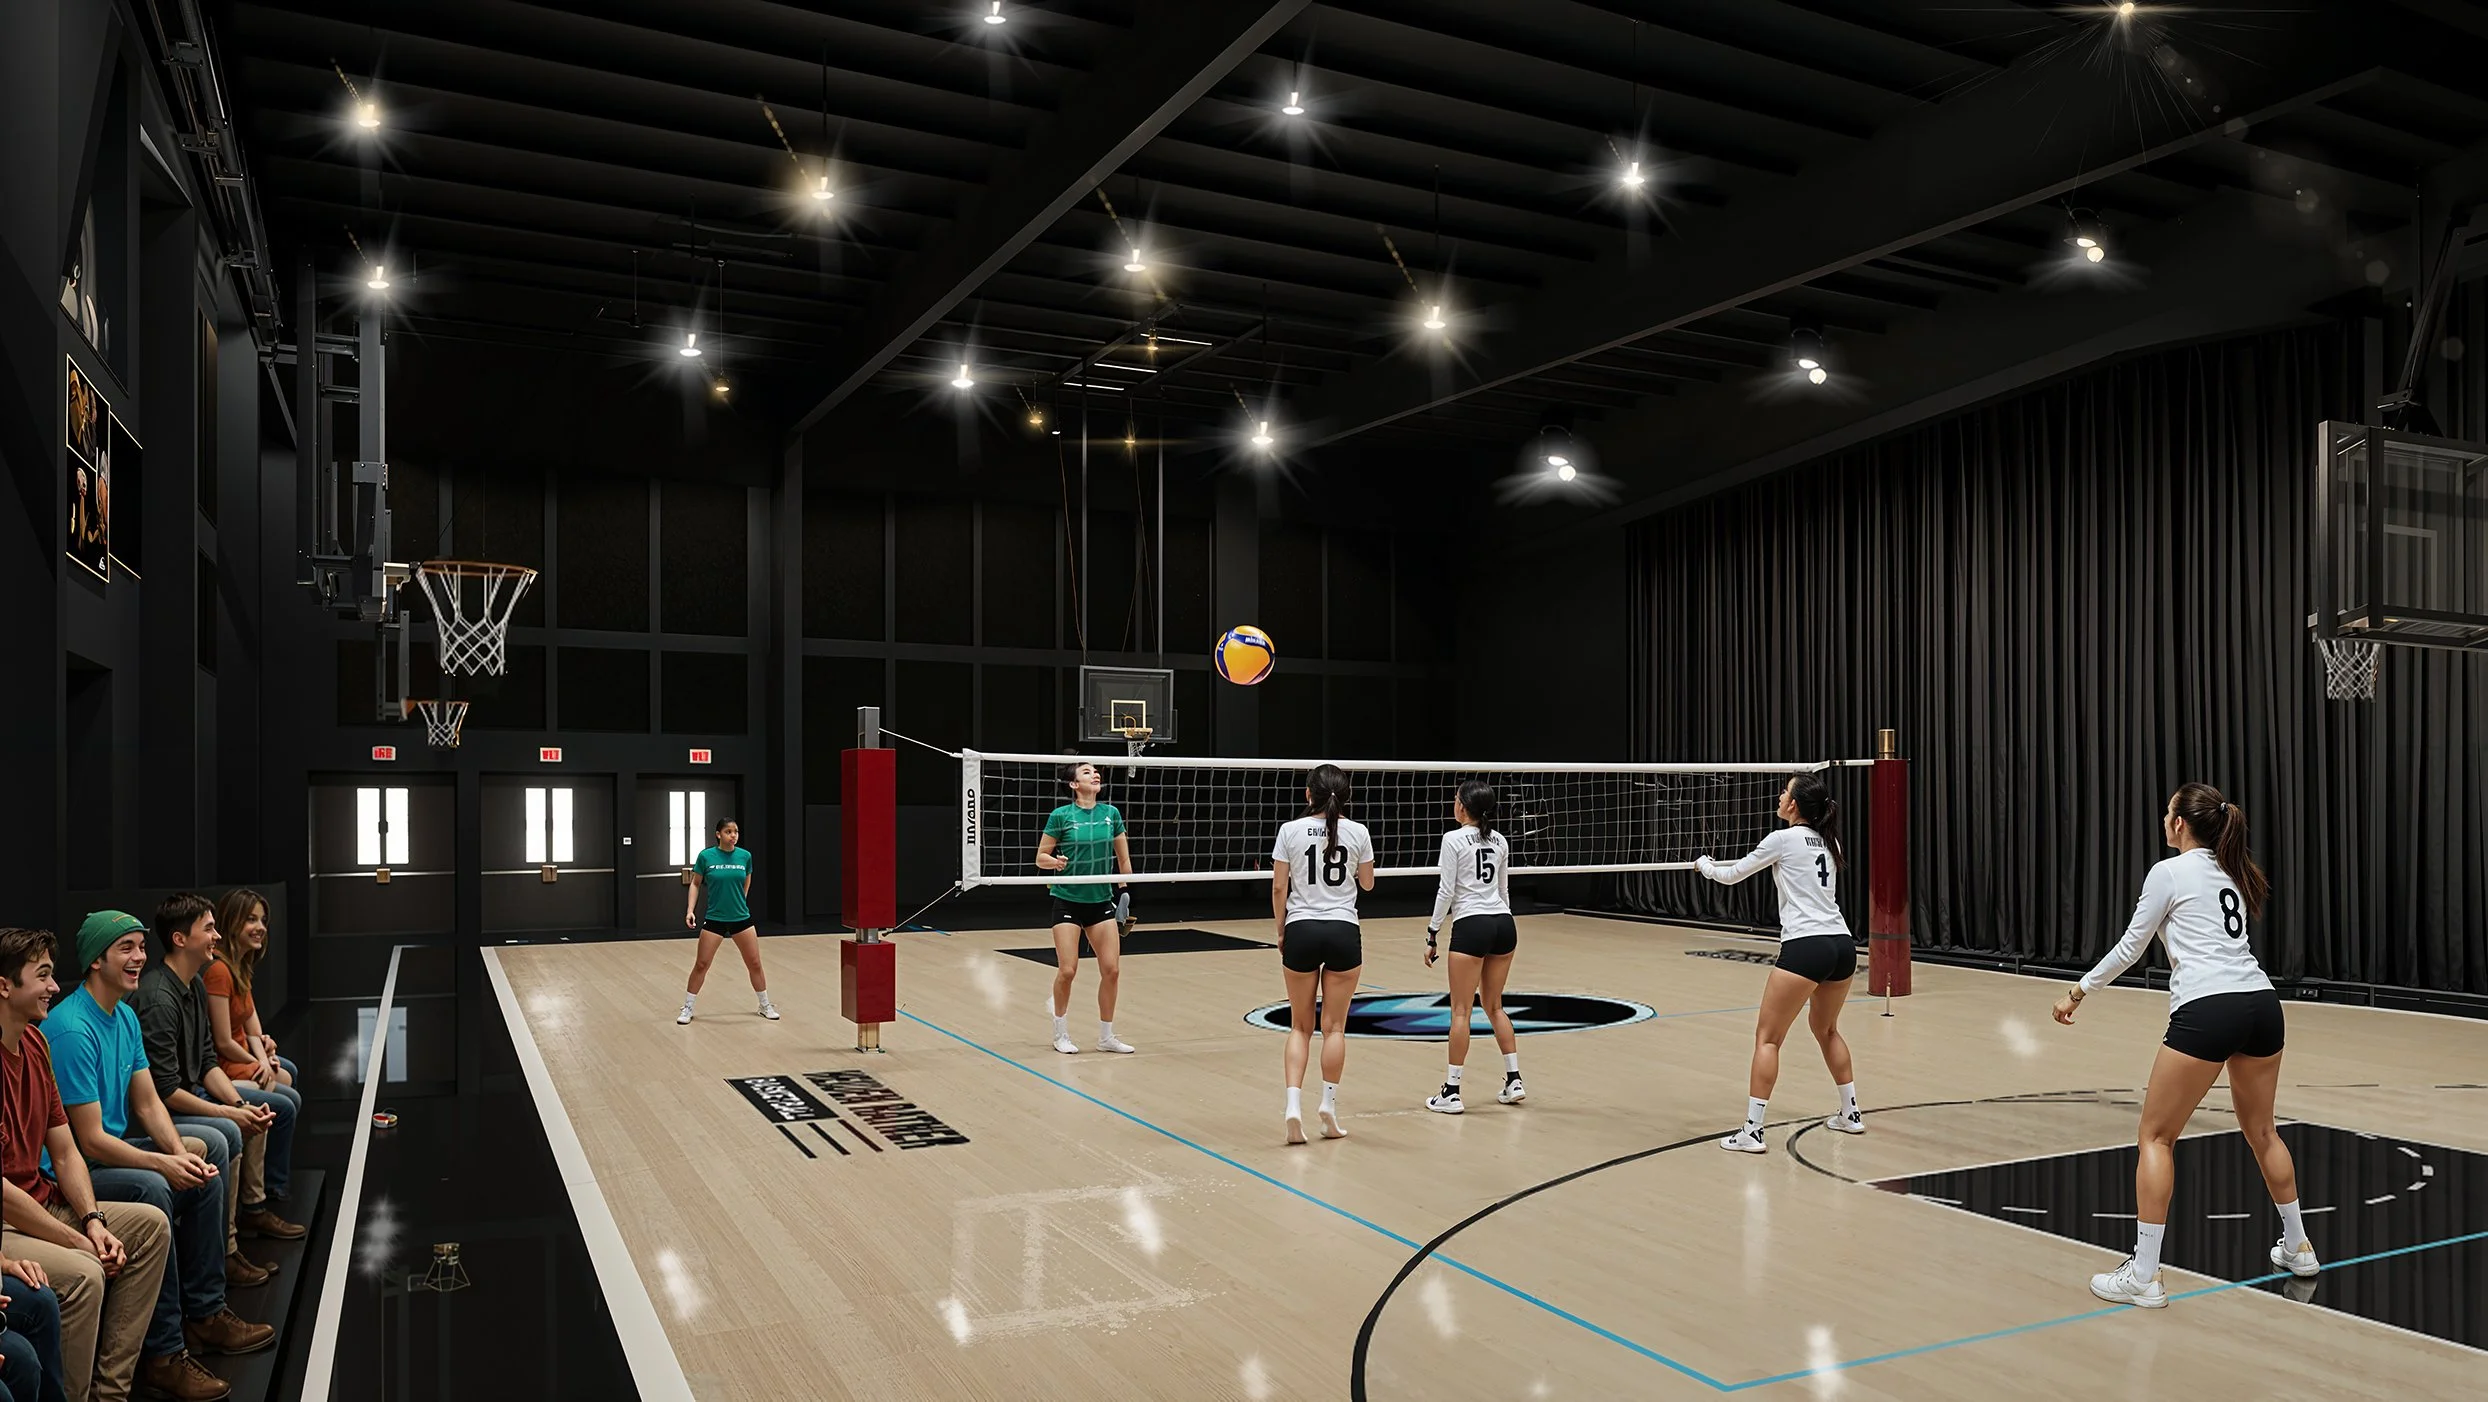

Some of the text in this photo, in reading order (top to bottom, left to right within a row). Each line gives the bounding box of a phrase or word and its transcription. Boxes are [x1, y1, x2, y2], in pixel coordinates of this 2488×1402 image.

[1304, 844, 1348, 887] 18
[1476, 848, 1496, 884] 15
[2219, 888, 2243, 939] 8
